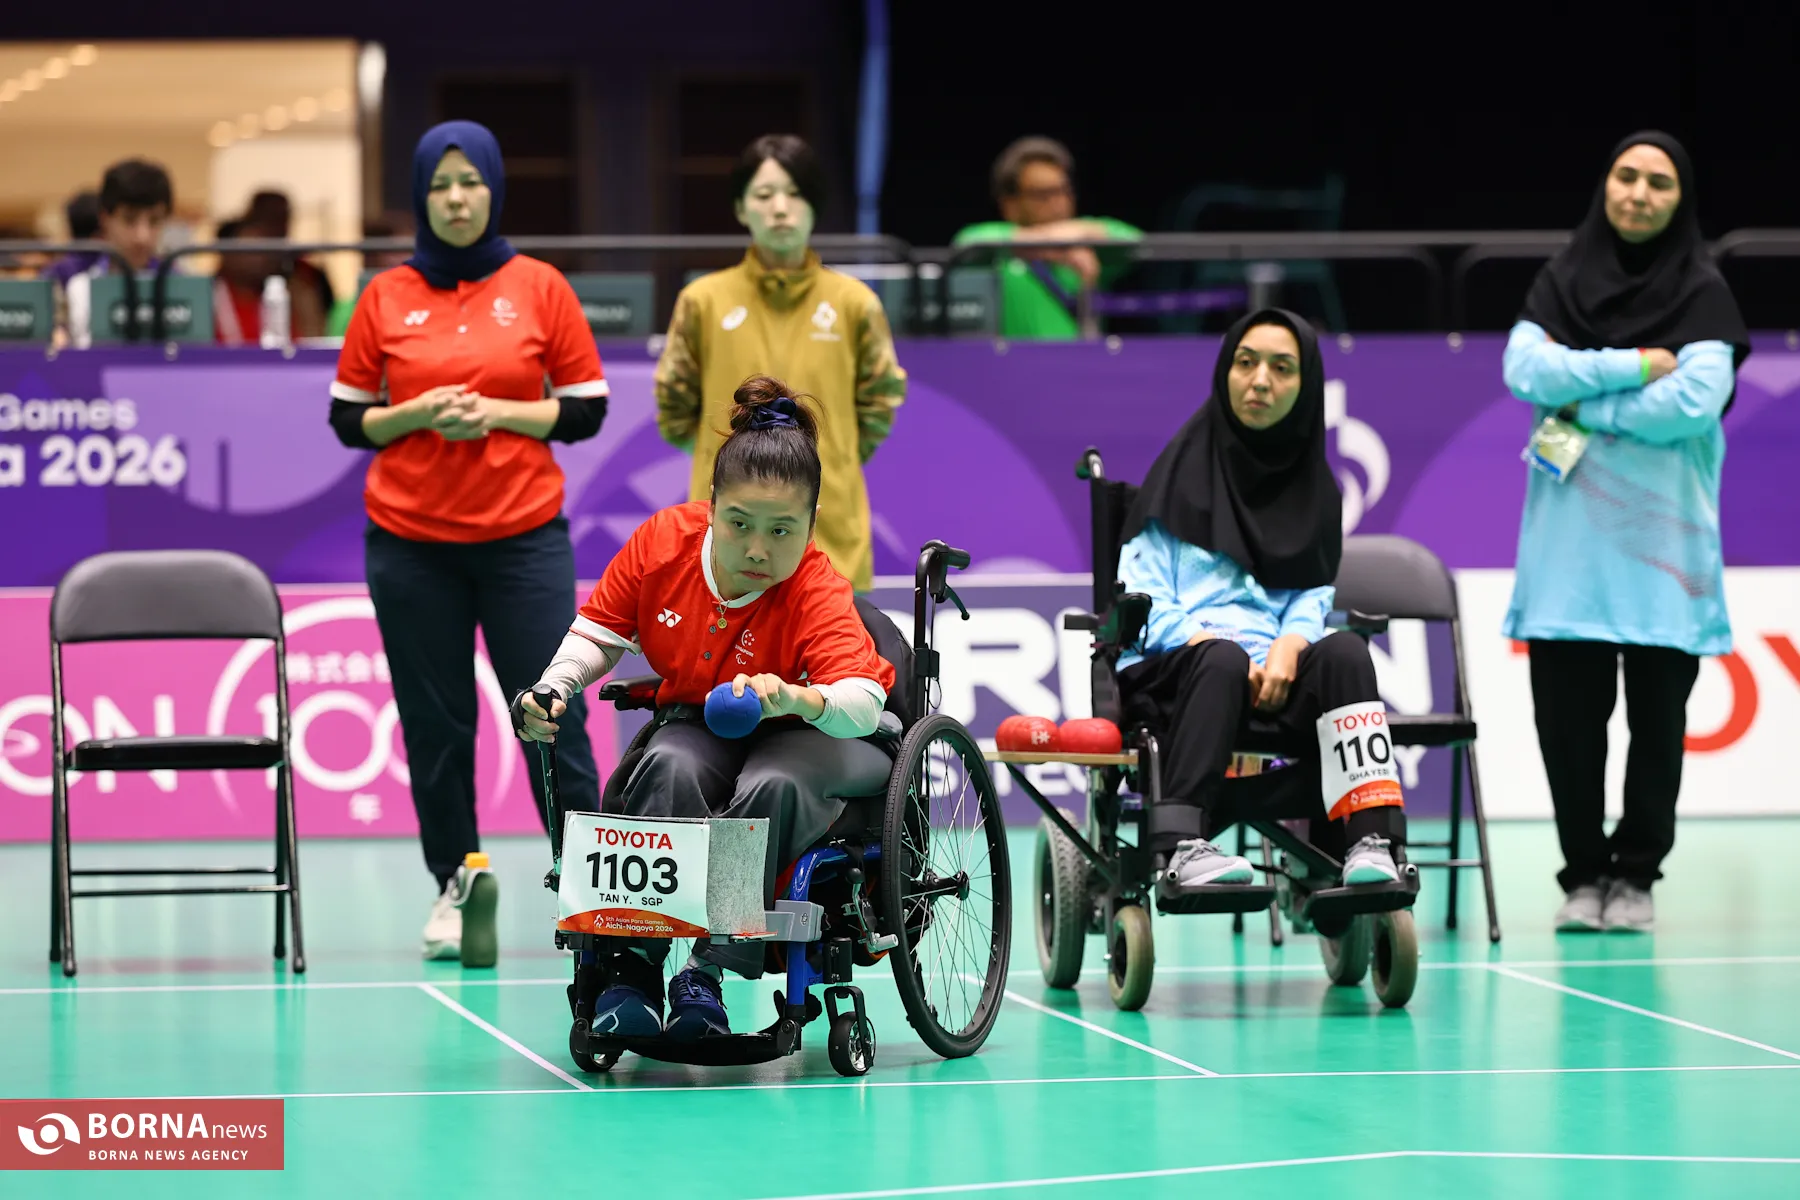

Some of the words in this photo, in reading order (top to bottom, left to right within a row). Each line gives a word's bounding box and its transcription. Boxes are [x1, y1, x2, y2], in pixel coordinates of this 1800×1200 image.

[39, 433, 188, 487] 2026
[1333, 711, 1388, 734] TOYO
[1333, 732, 1390, 773] 110
[595, 828, 673, 850] TOYOTA
[586, 851, 679, 894] 1103
[599, 893, 620, 904] TAN
[623, 896, 632, 905] Y.
[641, 897, 663, 907] SGP
[605, 922, 654, 933] Aichi-Nagoya
